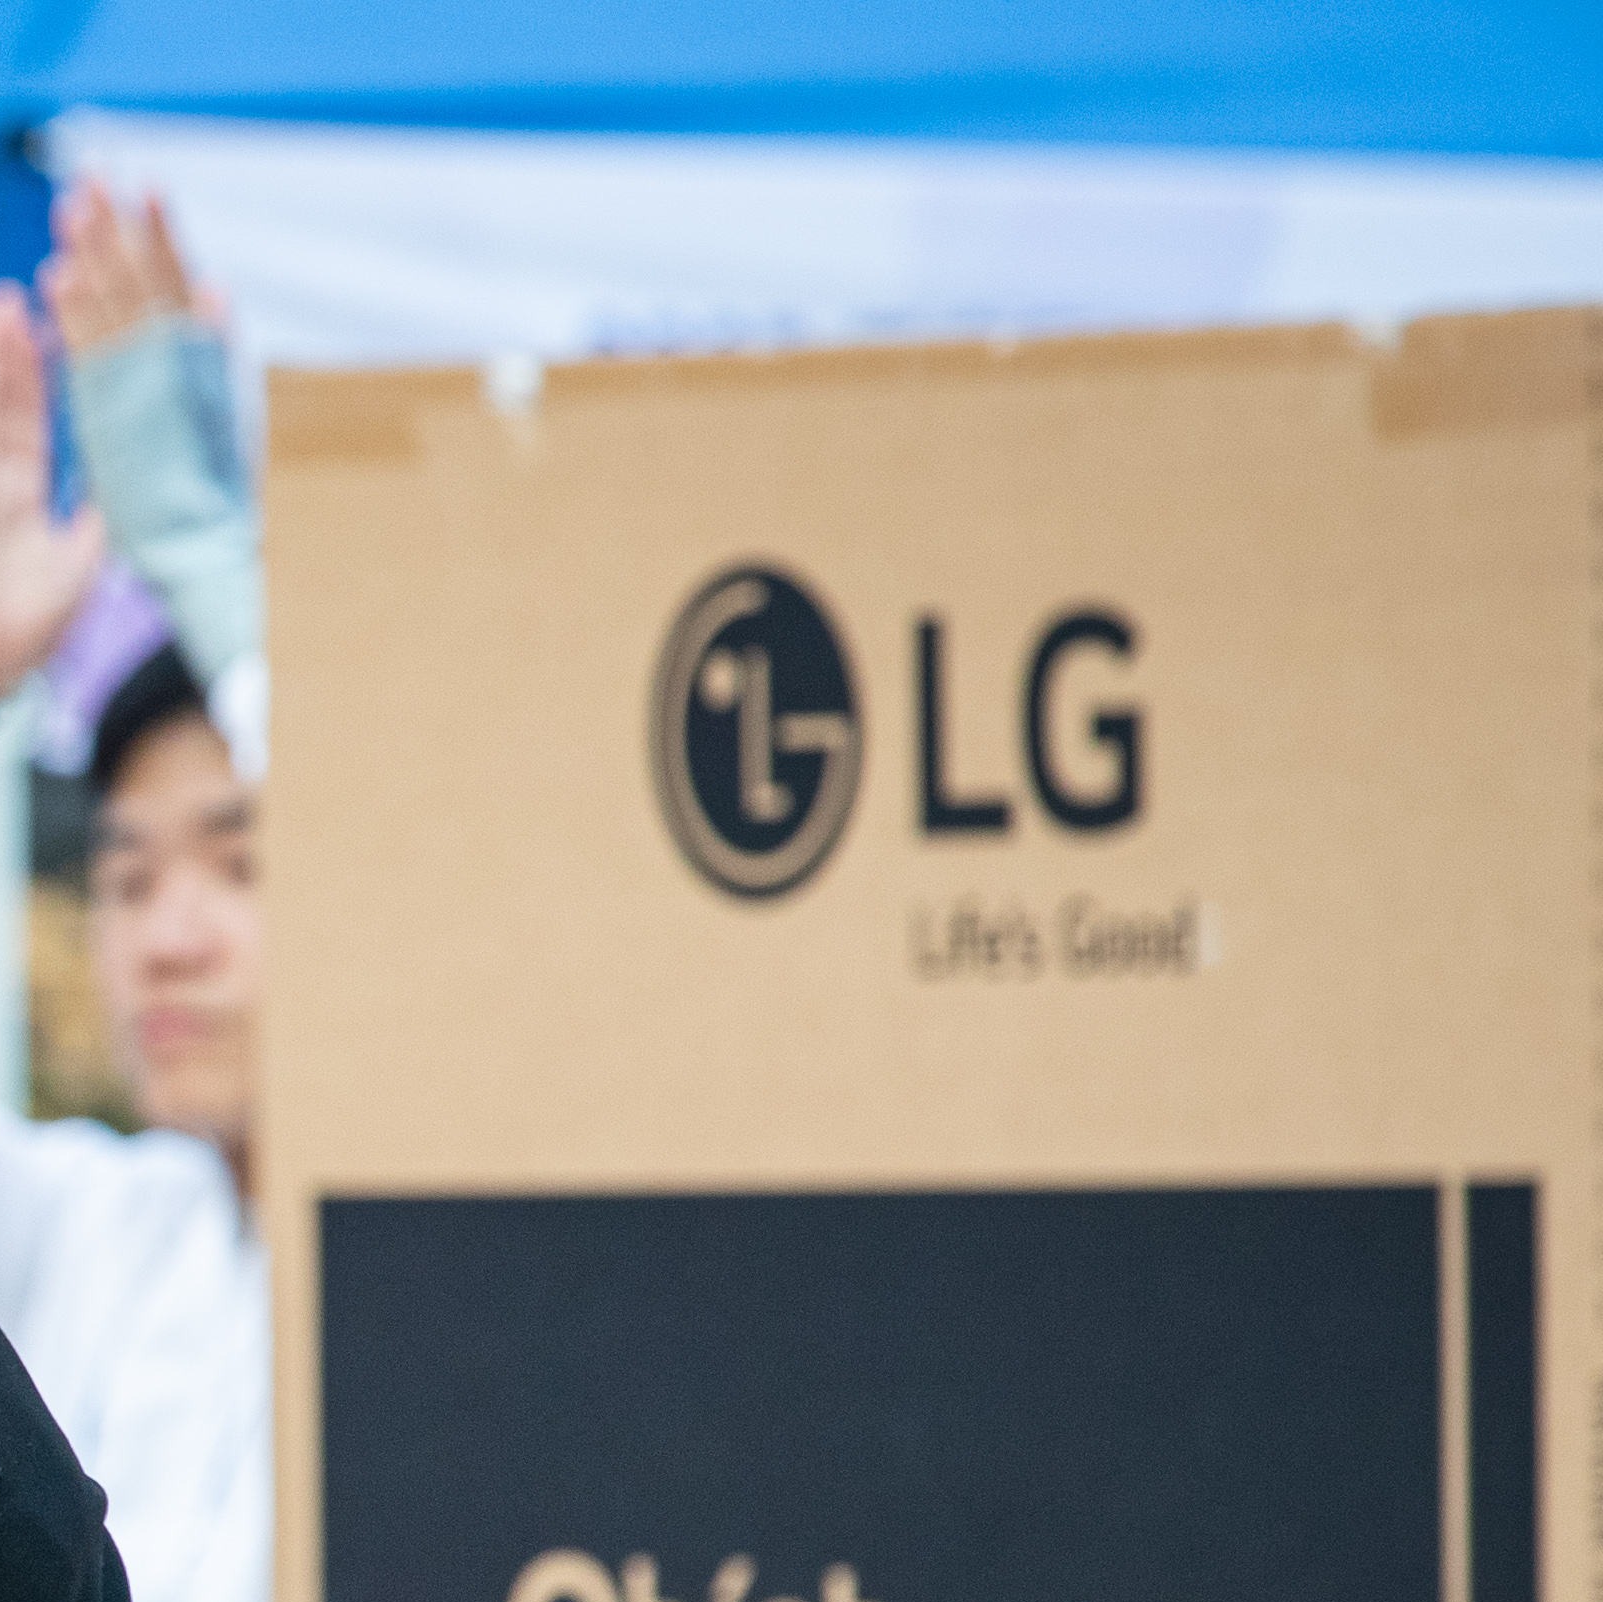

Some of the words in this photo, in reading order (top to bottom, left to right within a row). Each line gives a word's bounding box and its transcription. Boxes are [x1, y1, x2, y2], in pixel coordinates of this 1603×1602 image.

[912, 602, 1146, 840] LG
[914, 898, 1044, 978] Life's
[1058, 895, 1197, 978] Good
